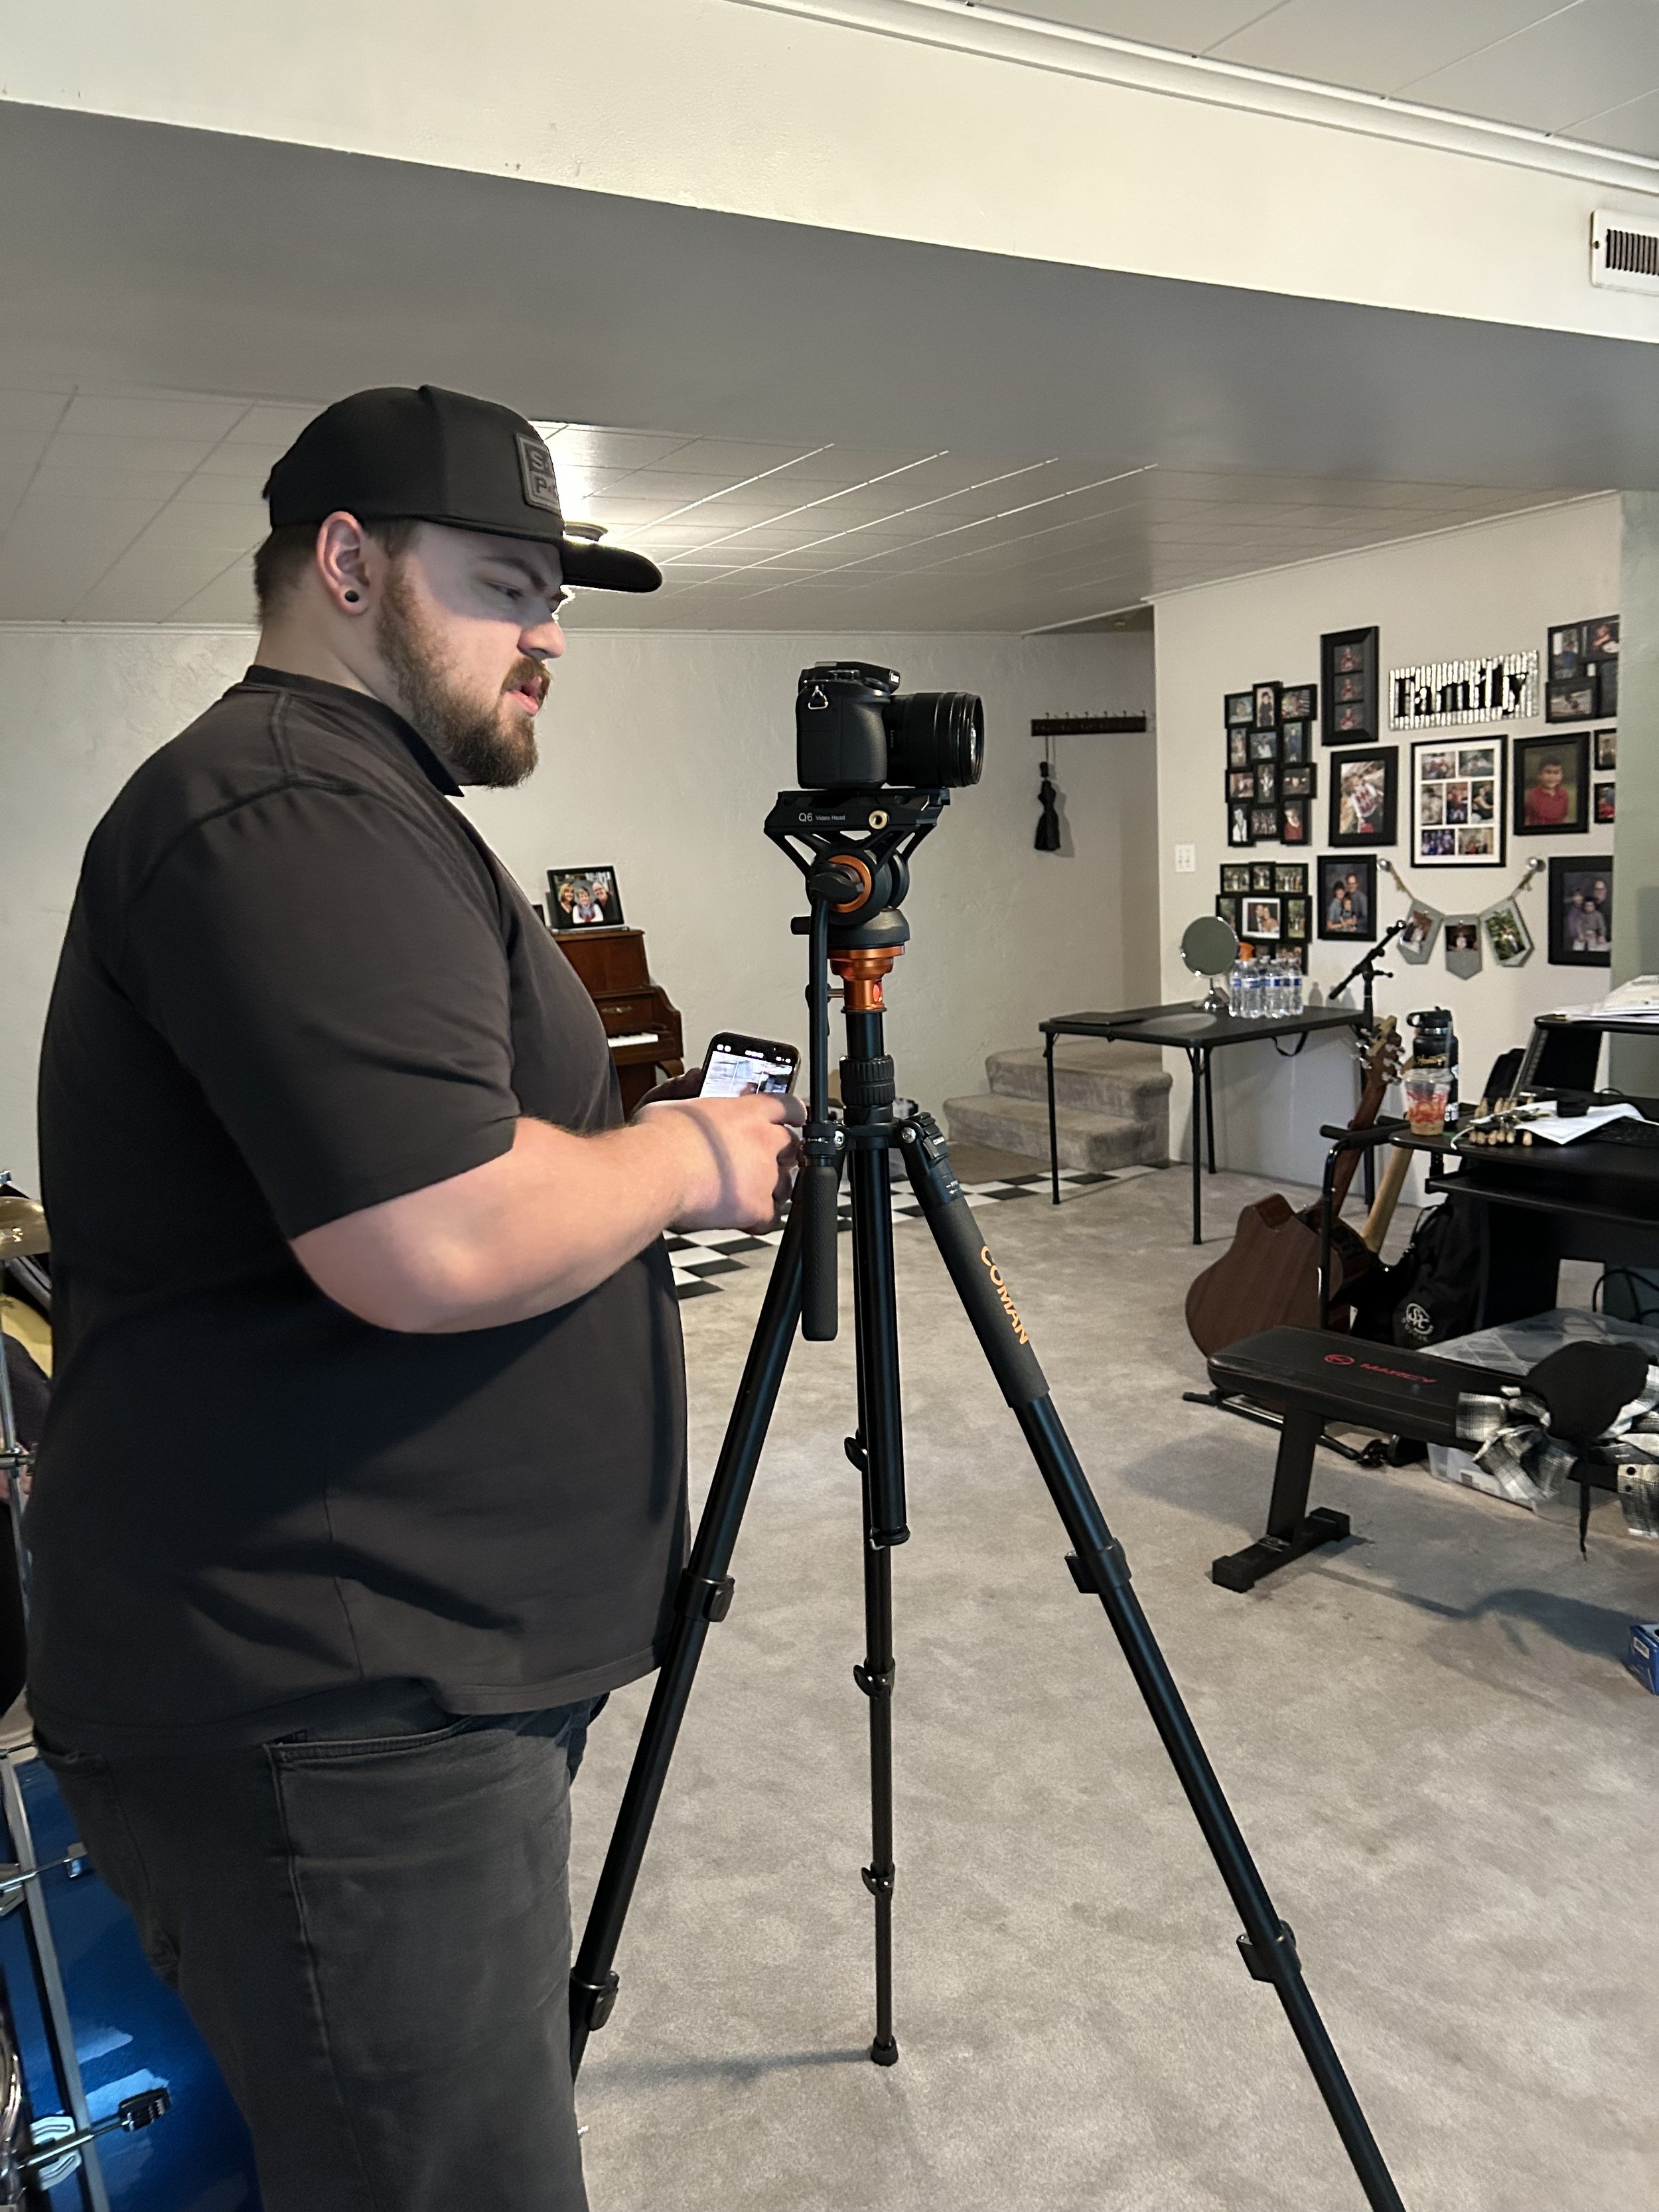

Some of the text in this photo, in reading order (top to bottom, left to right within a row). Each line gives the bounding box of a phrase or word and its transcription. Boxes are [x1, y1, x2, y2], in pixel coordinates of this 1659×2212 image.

[1395, 658, 1529, 718] Family
[798, 812, 813, 823] Q6
[981, 1246, 1029, 1345] COMAN
